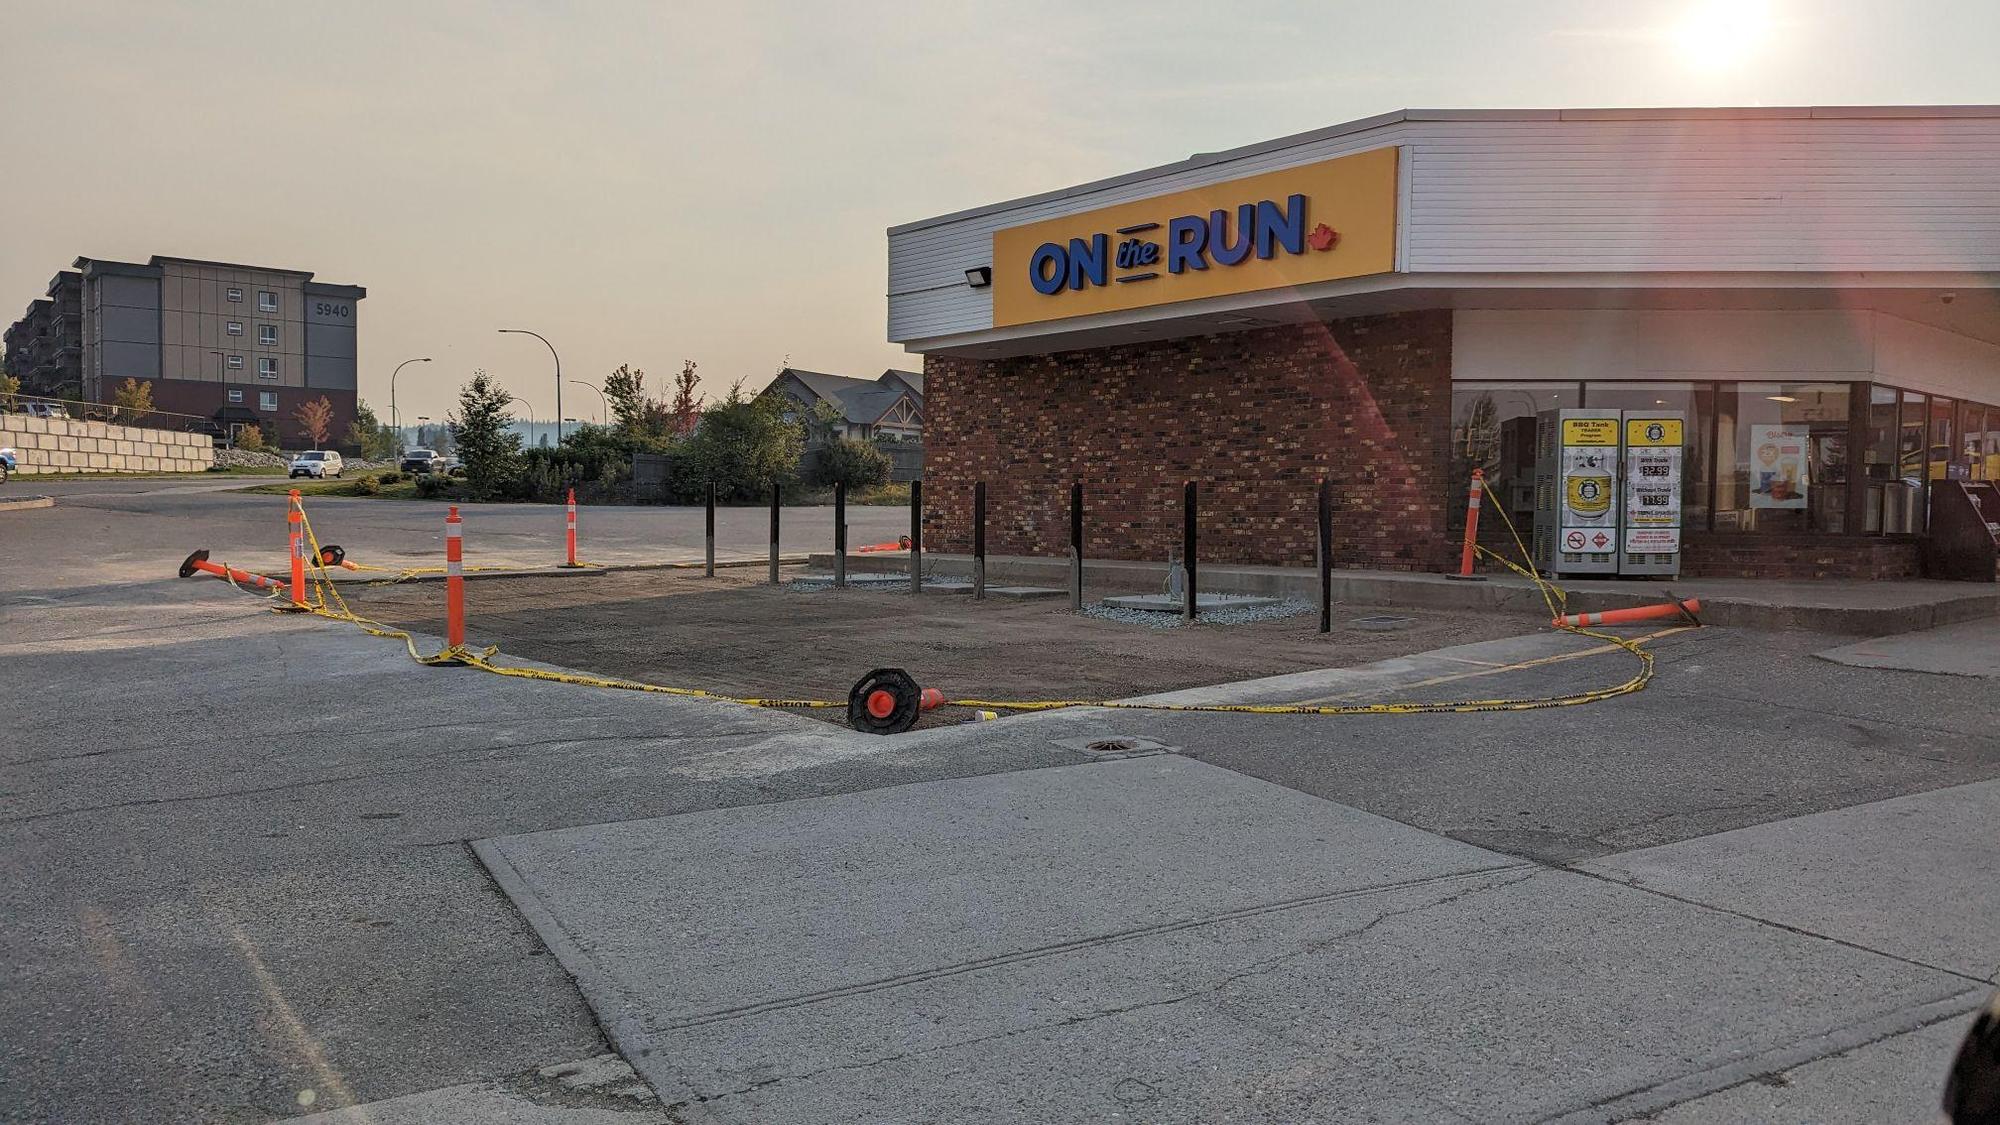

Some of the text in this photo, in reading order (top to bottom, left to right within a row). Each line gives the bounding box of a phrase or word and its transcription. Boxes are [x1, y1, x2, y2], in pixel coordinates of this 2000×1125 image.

[1029, 193, 1306, 295] ON the RUN
[316, 303, 349, 318] 5940
